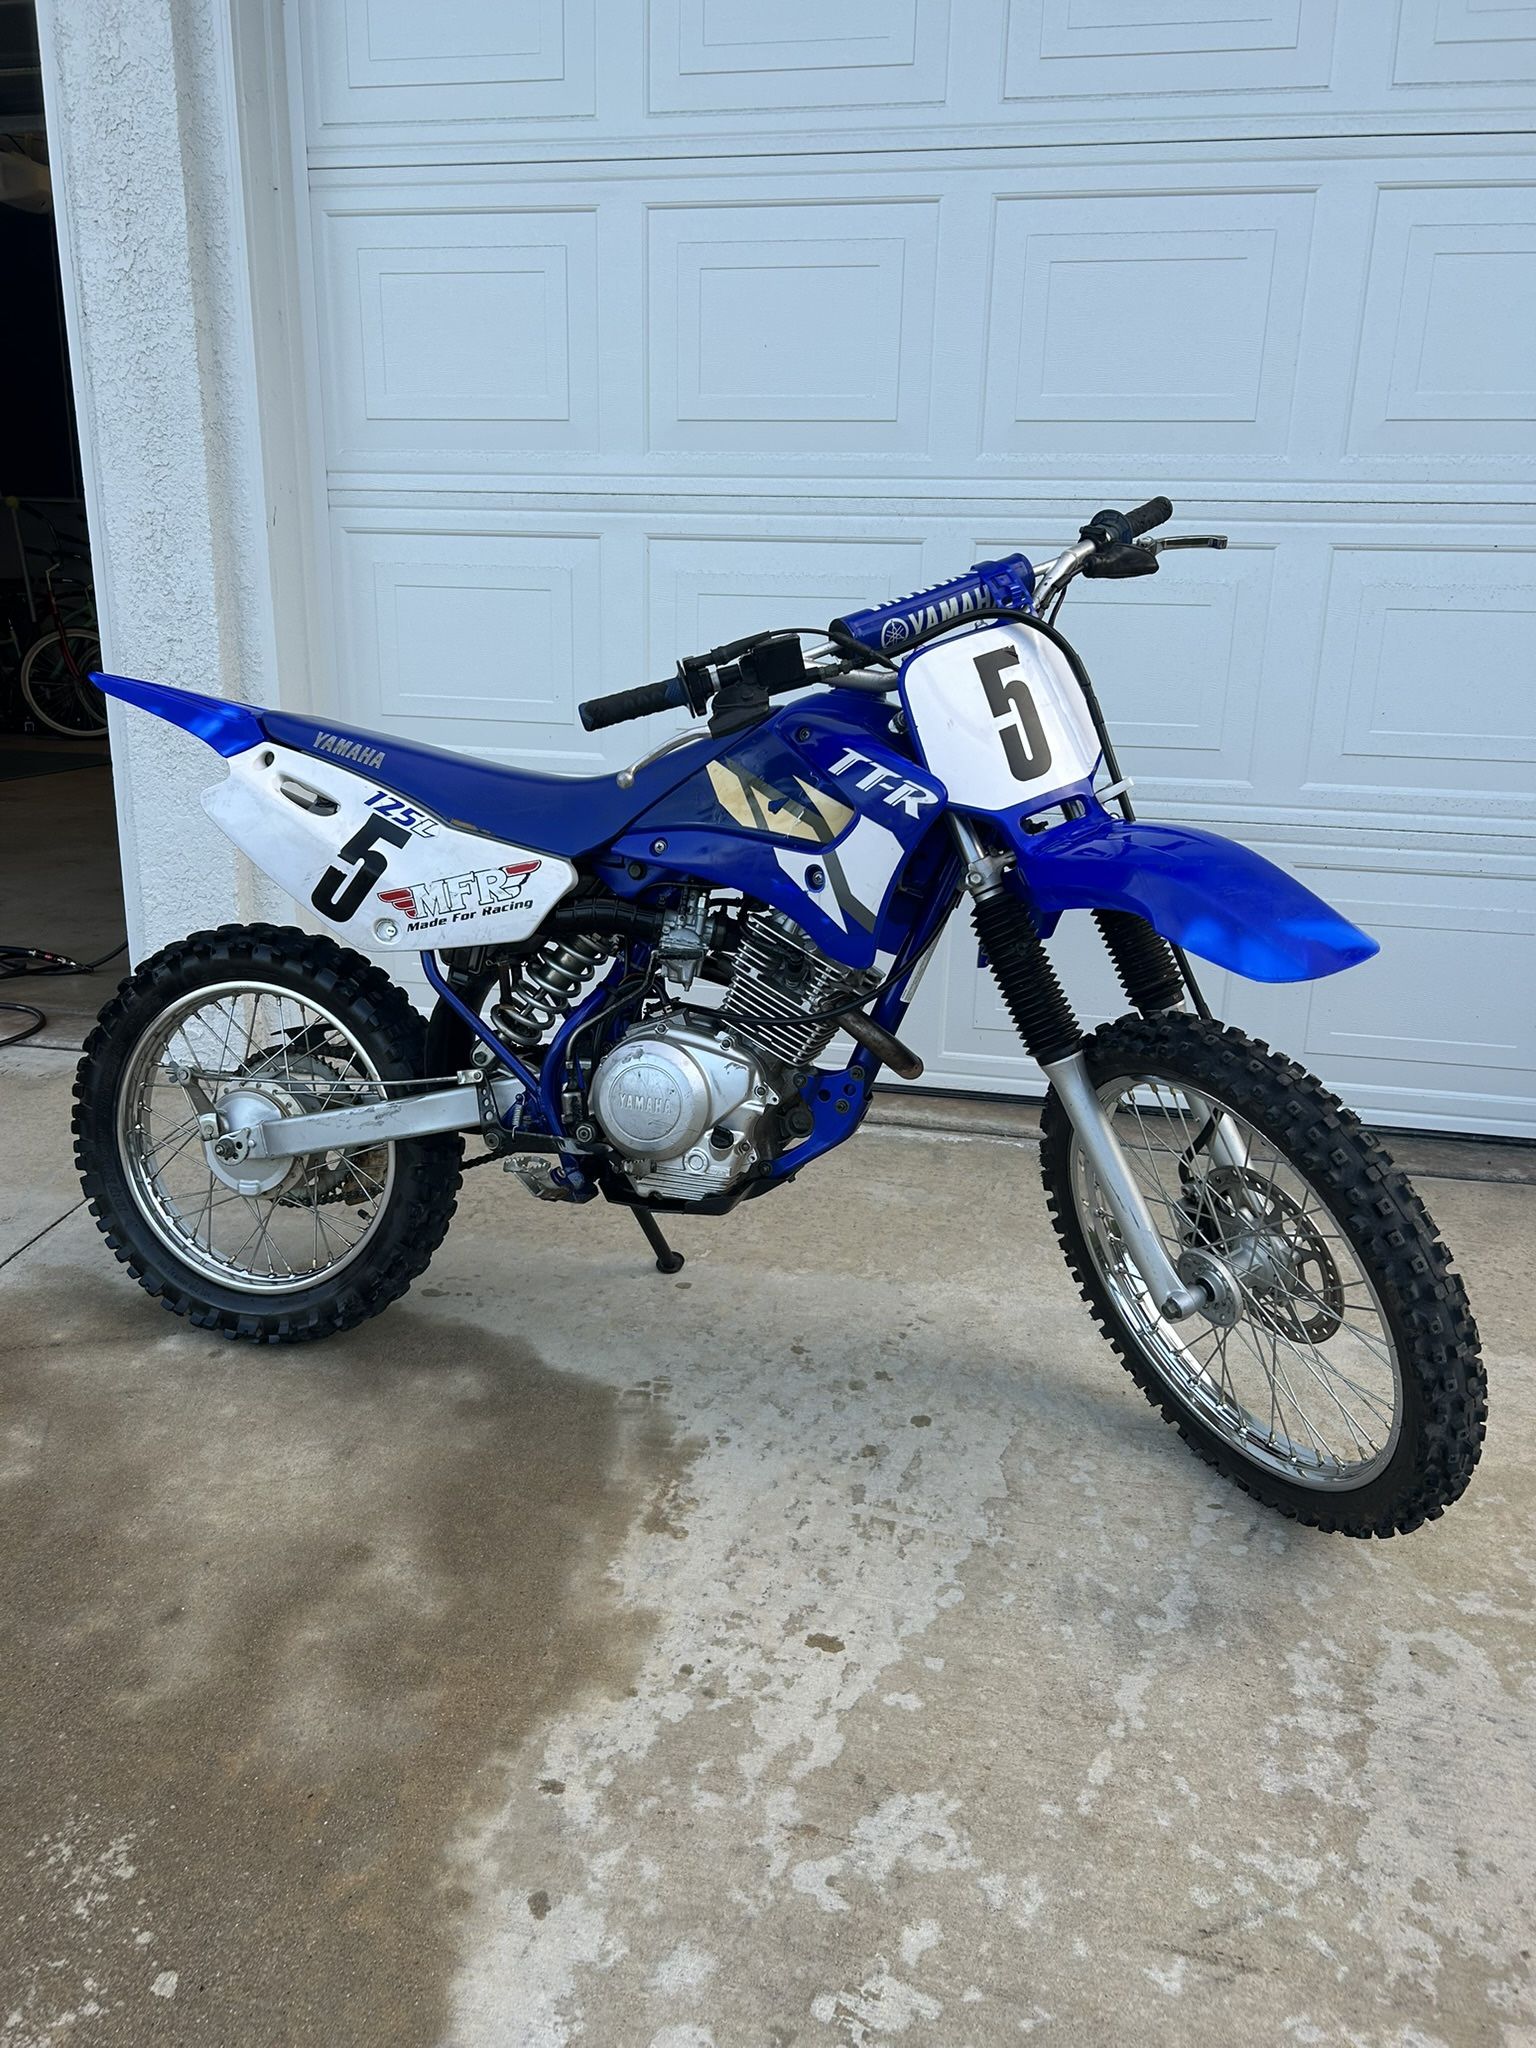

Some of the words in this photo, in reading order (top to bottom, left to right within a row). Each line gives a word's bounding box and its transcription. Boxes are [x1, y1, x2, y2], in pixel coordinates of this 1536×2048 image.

[907, 584, 995, 636] YAMAH
[972, 644, 1052, 782] 5
[313, 731, 386, 769] YAMAHA
[827, 747, 939, 820] TT-R
[311, 812, 413, 923] 5
[407, 917, 447, 932] Made
[452, 911, 477, 923] For
[482, 899, 534, 916] Racing
[411, 868, 514, 919] MFR
[619, 1093, 672, 1115] YAMAHA
